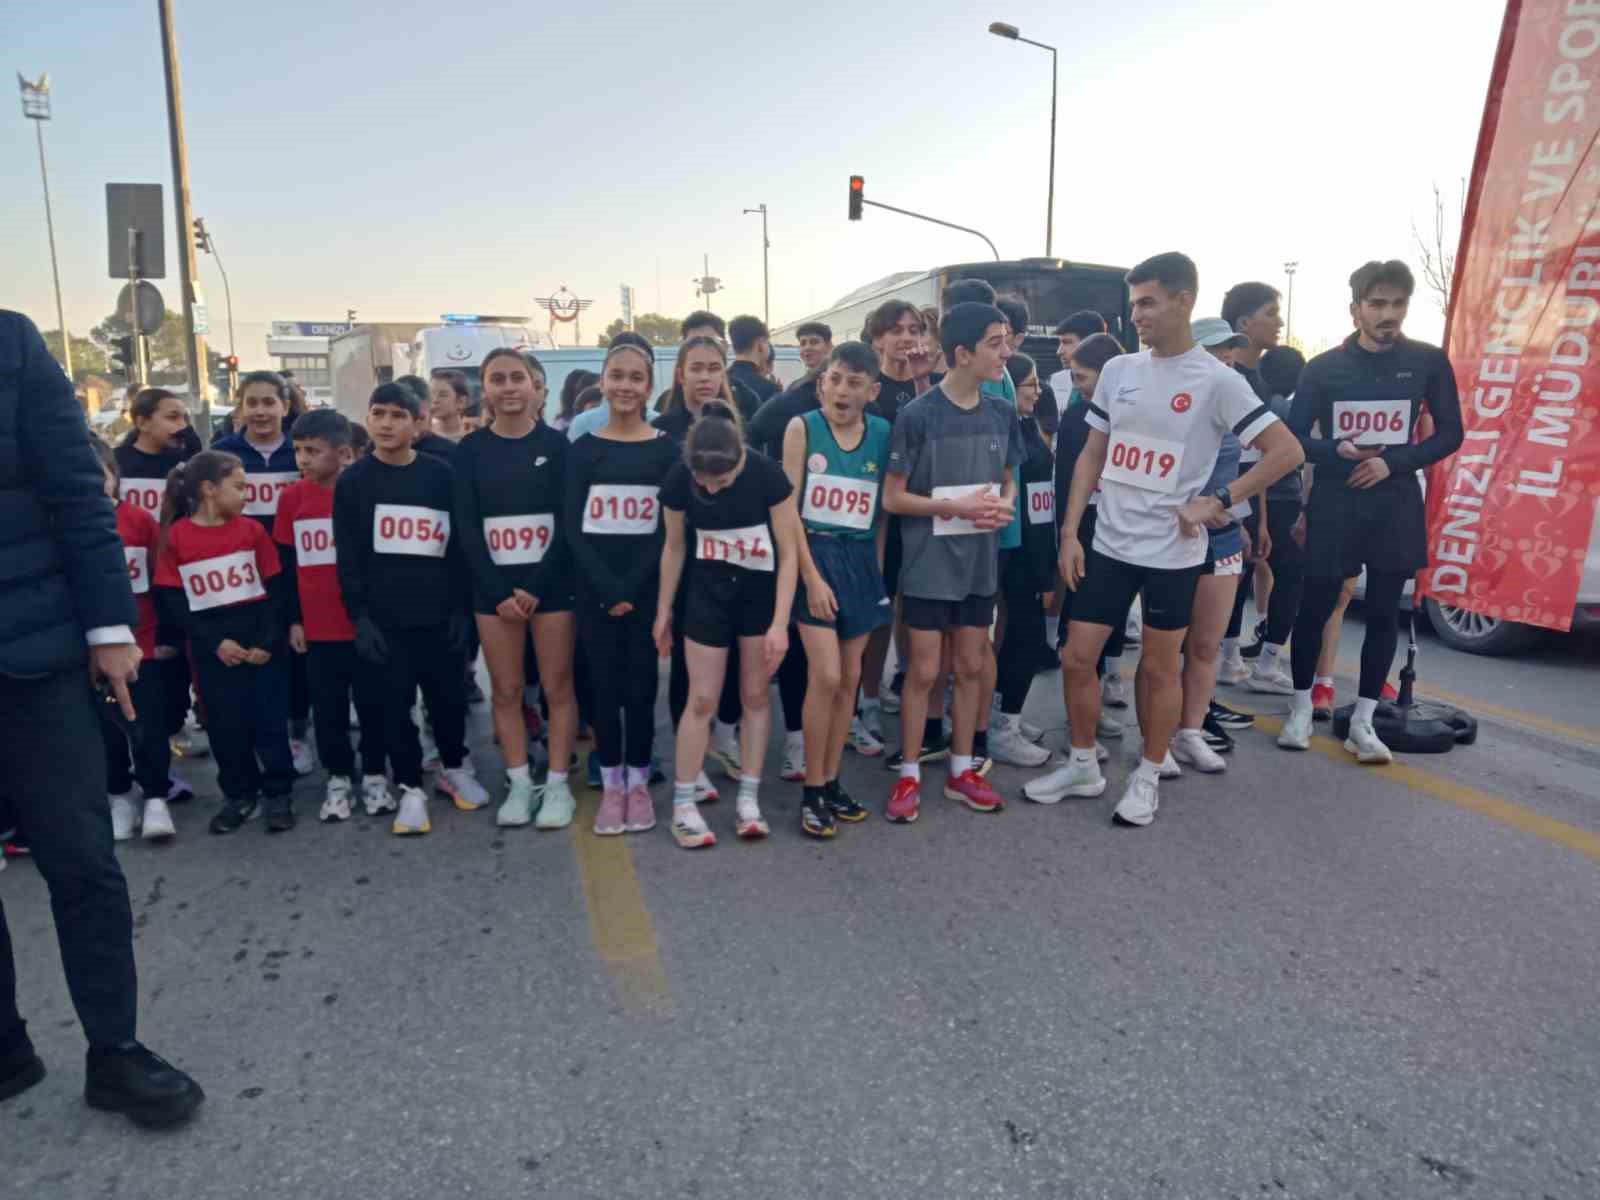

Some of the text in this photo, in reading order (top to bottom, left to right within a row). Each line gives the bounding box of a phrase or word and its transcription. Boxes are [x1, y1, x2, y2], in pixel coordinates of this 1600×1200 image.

[1520, 139, 1574, 203] VE
[1338, 410, 1404, 433] 0006
[1111, 442, 1176, 479] 0019
[1504, 459, 1564, 498] İL
[591, 496, 654, 520] 0102
[811, 485, 871, 515] 0095
[380, 516, 446, 543] 0054
[488, 526, 550, 551] 0099
[189, 562, 257, 597] 0063
